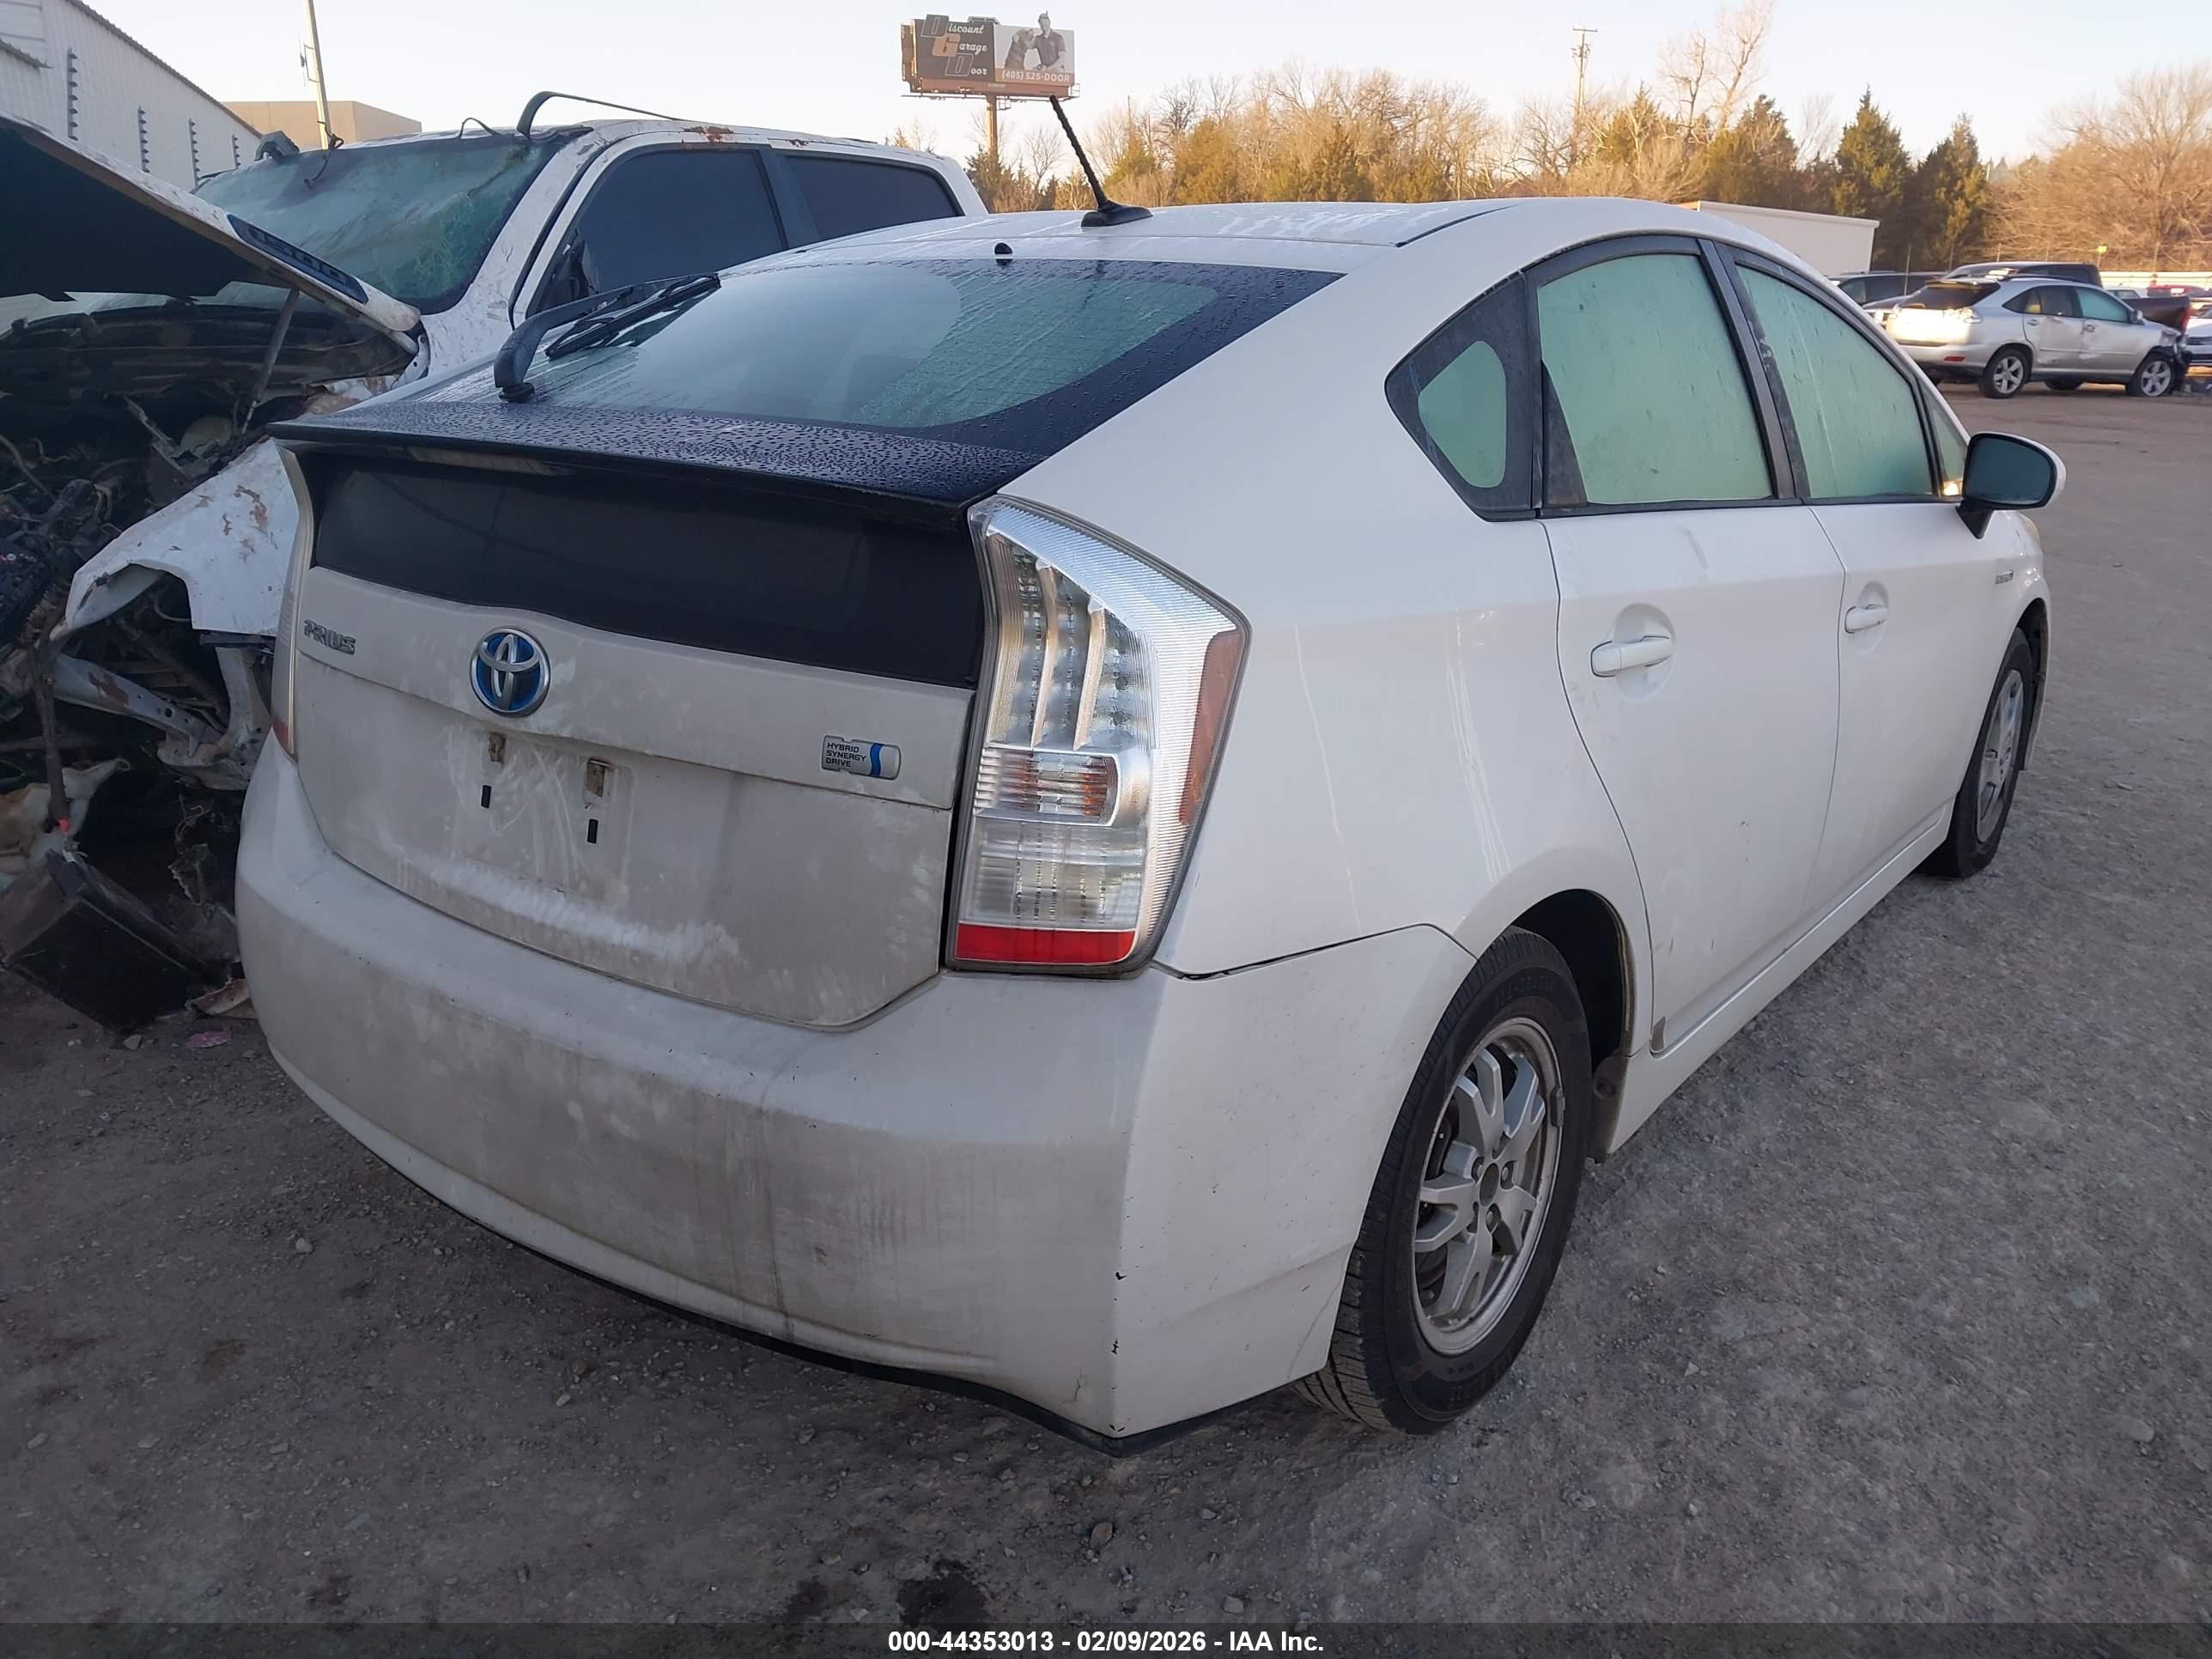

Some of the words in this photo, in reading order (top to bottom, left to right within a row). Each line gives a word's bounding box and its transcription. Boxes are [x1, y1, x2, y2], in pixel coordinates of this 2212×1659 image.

[921, 14, 984, 38] Discount
[932, 33, 988, 57] Garage
[945, 53, 988, 76] Door
[1001, 69, 1024, 81] (405)
[1025, 70, 1070, 83] 525-DOOR
[303, 618, 356, 655] PRIUS
[826, 750, 866, 762] SYNERGY
[827, 742, 860, 753] HYBRID
[825, 757, 852, 768] DRIVE
